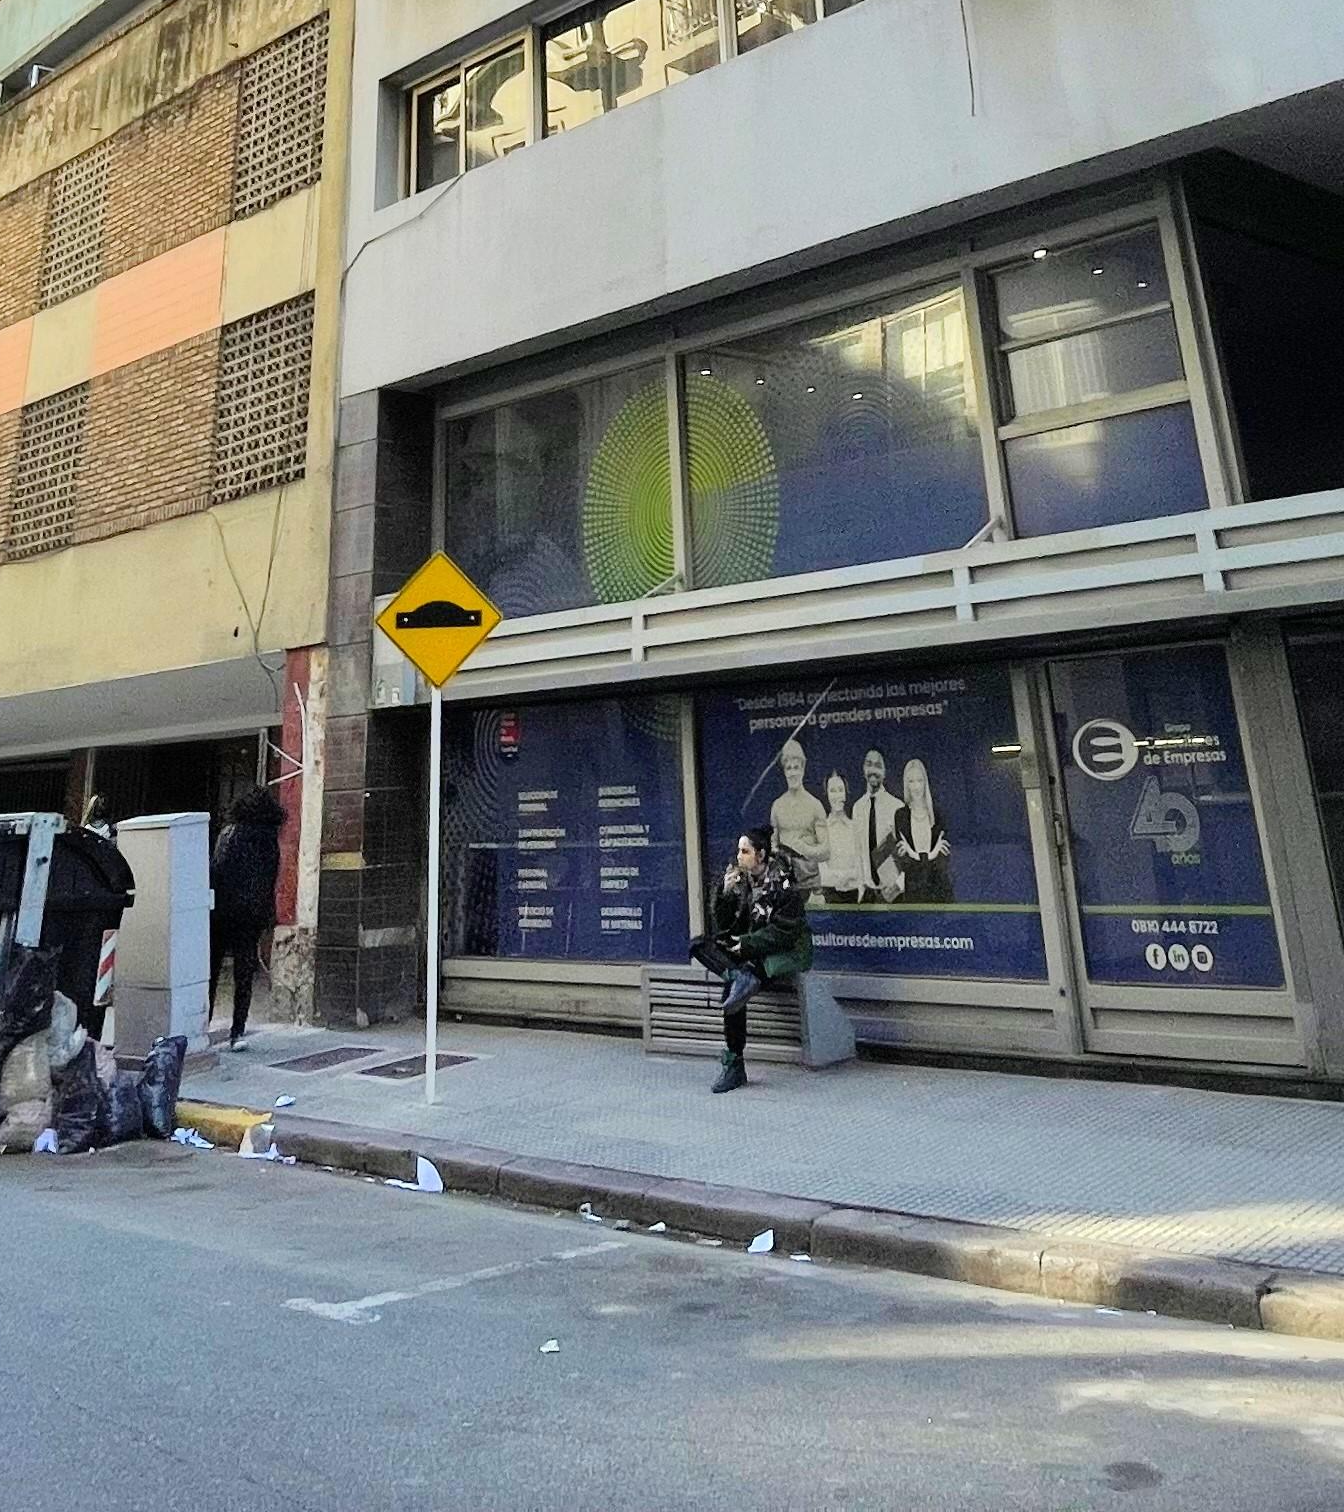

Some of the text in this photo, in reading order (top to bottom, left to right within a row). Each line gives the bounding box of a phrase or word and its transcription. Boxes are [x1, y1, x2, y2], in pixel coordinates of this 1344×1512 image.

[886, 681, 906, 697] las
[908, 677, 966, 697] mejores
[749, 713, 807, 734] personas
[819, 705, 873, 729] grandes
[1143, 749, 1227, 766] de Empresas
[1131, 919, 1219, 935] 0810 444 8722
